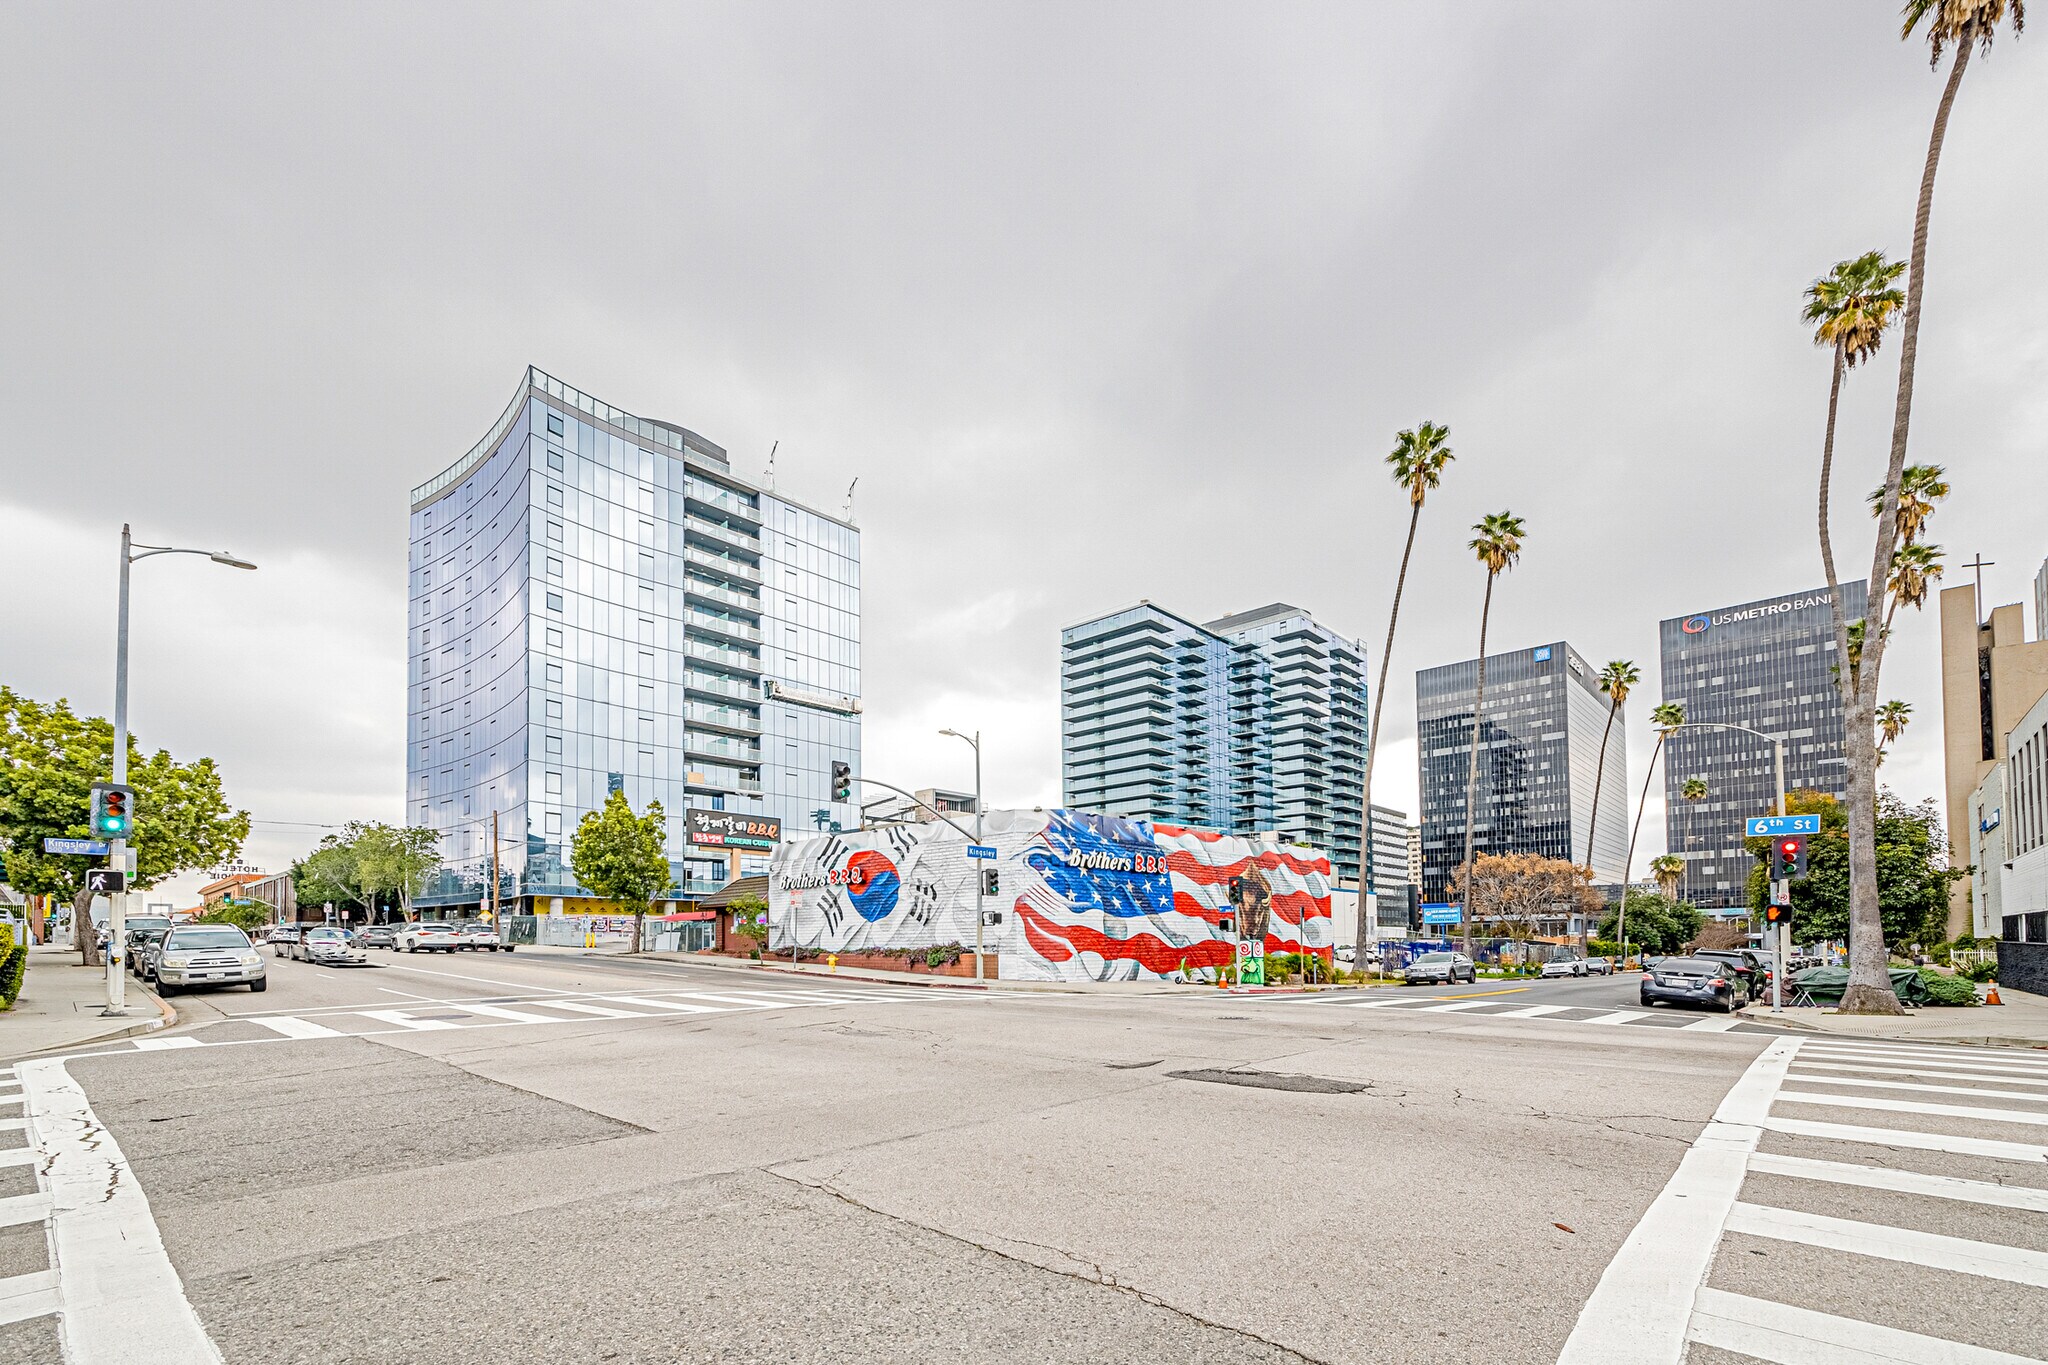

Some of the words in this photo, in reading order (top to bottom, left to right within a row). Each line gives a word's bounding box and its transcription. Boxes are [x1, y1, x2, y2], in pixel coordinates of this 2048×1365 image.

[1712, 614, 1731, 626] US
[1733, 602, 1792, 622] METRO
[1754, 819, 1784, 834] 6th
[1793, 819, 1812, 830] St
[48, 840, 91, 850] Kingsley
[724, 837, 752, 846] KOREAN
[969, 848, 996, 858] Kingsley
[1069, 848, 1132, 872] Brothers
[780, 872, 826, 890] Brothers
